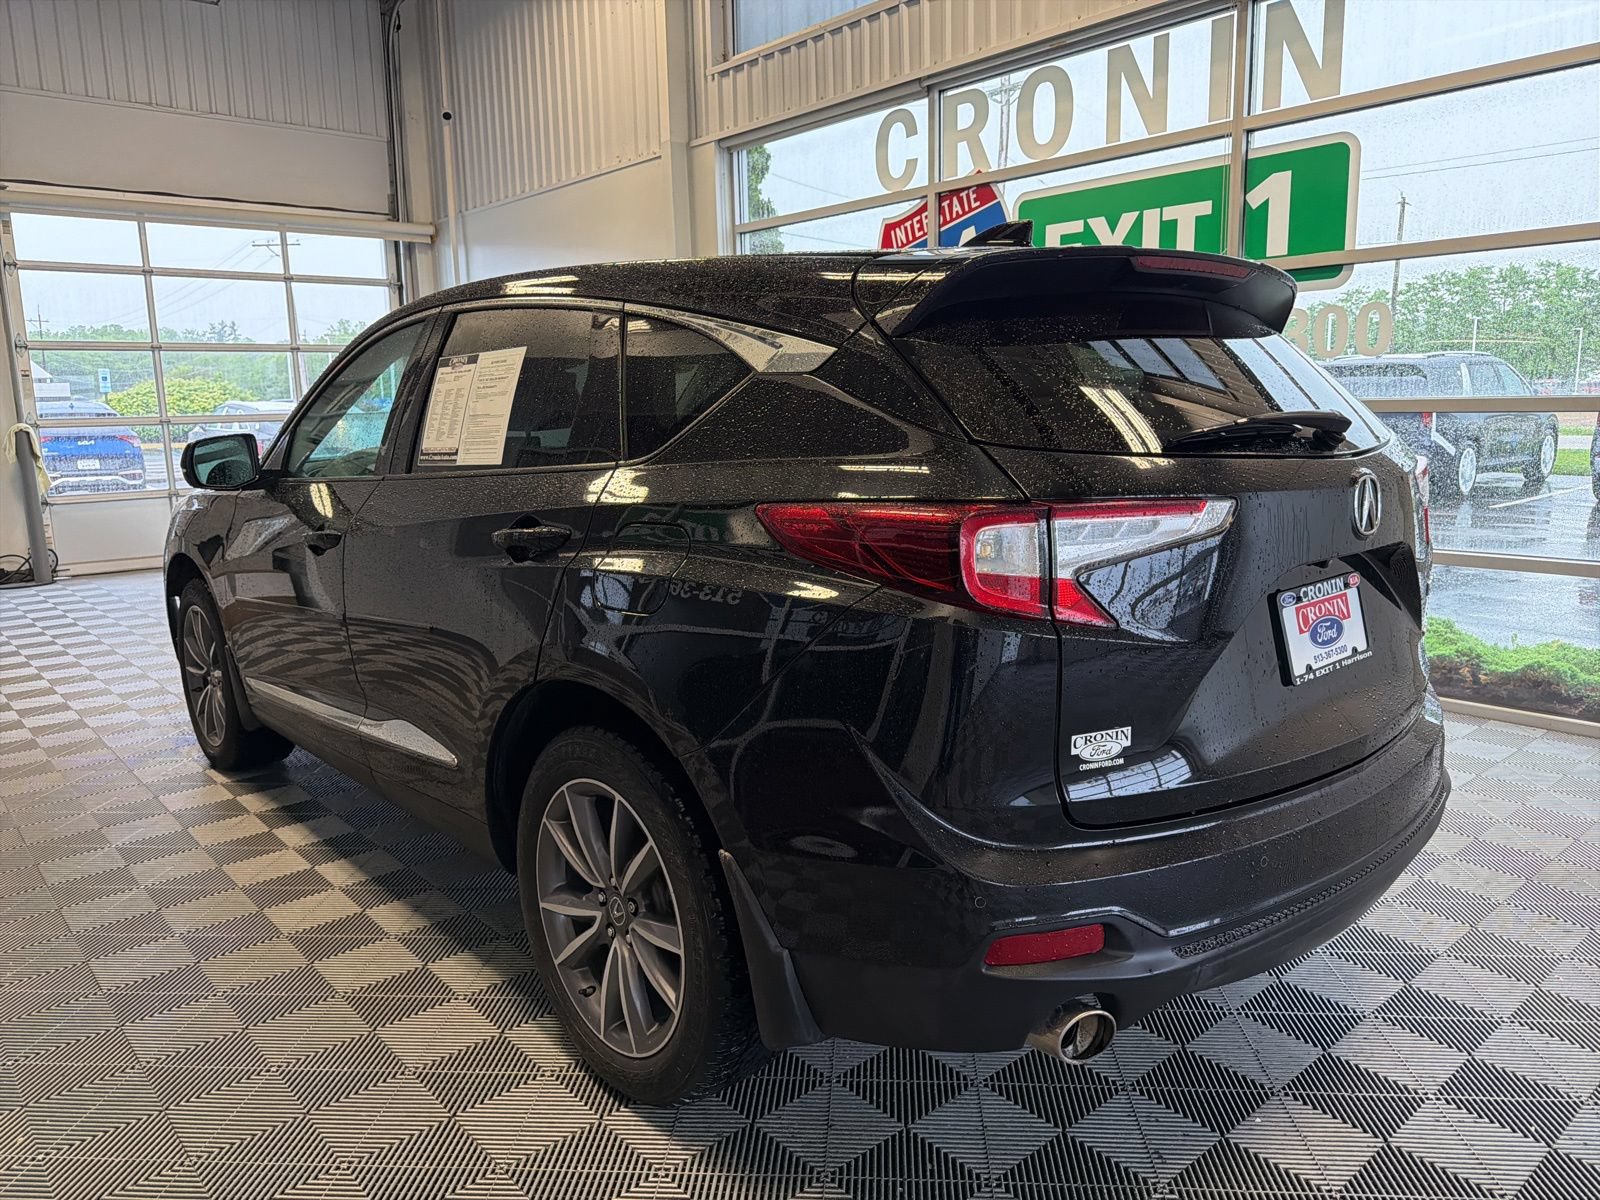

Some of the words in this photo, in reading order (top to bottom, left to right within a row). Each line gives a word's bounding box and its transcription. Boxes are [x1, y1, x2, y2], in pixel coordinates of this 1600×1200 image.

[875, 0, 1345, 191] CRONIN
[891, 187, 980, 249] INTERTATE
[1246, 170, 1292, 257] 1
[1300, 577, 1345, 602] CRONIN
[1298, 596, 1348, 632] CRONIN
[1316, 621, 1338, 643] Ford
[1313, 644, 1348, 664] 513-367-5300
[1295, 672, 1314, 686] I-74
[1316, 664, 1333, 677] EXIT
[1335, 662, 1341, 670] 1
[1341, 650, 1373, 667] Harrison
[1073, 728, 1129, 750] CRONIN
[1089, 744, 1113, 758] Ford
[1079, 758, 1124, 771] CRONINFORD.COM
